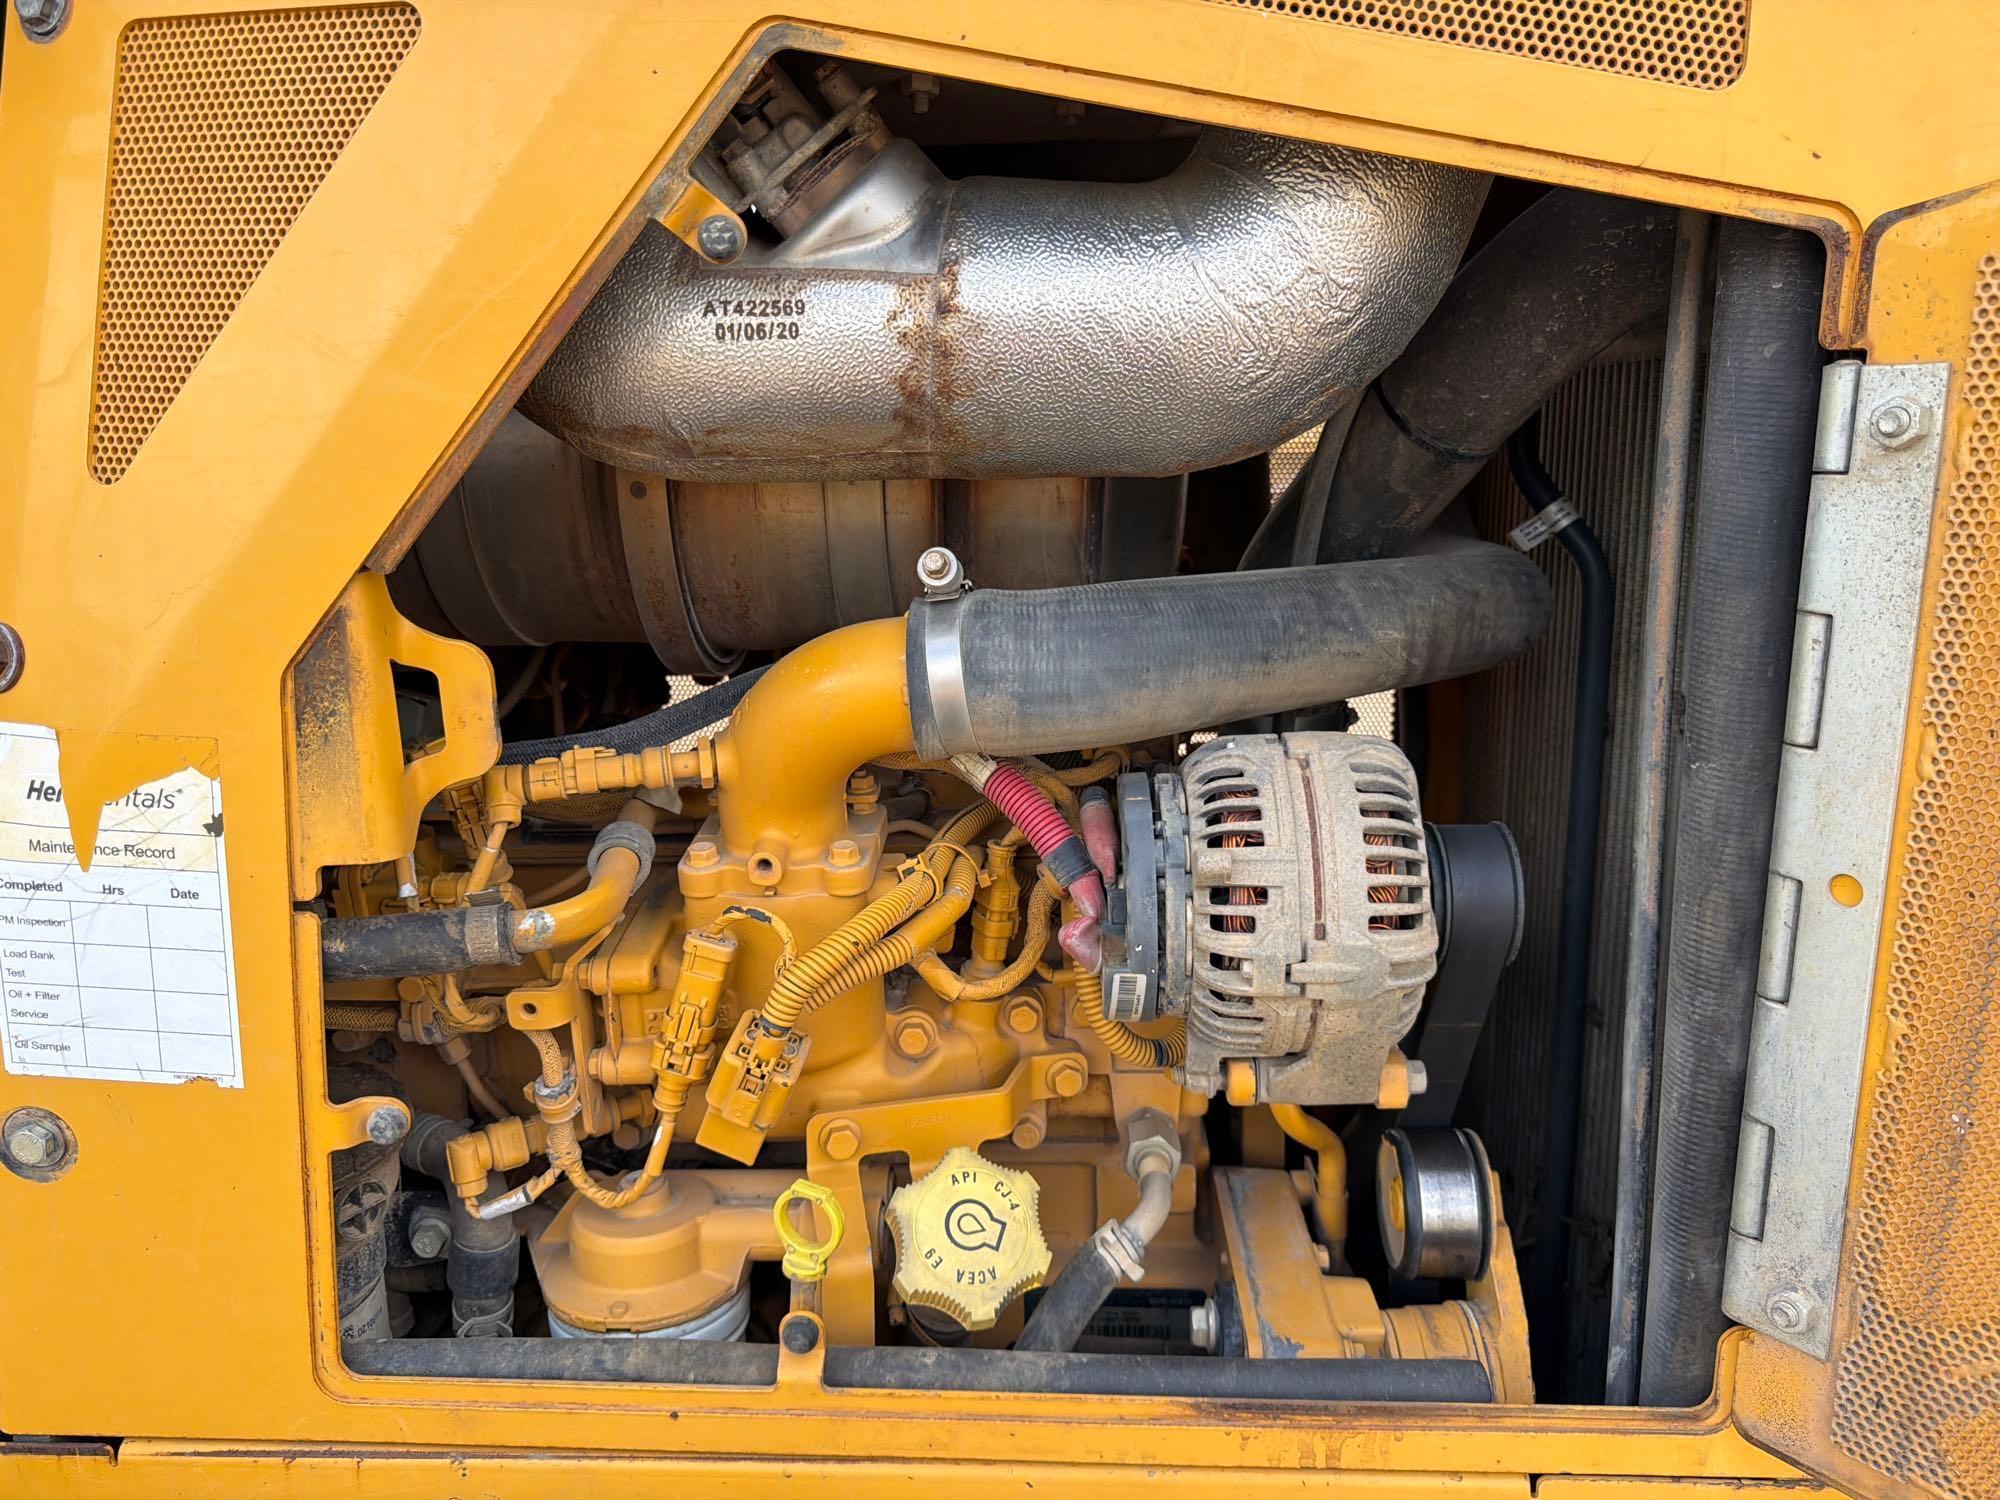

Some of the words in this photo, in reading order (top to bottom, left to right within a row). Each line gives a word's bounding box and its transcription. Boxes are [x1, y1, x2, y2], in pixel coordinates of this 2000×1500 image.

[702, 299, 806, 317] AT422569
[715, 321, 800, 341] 01/06/20
[26, 779, 62, 803] Her
[28, 838, 120, 857] Maintence
[123, 844, 176, 860] Record
[102, 884, 125, 896] Hrs
[170, 888, 200, 900] Date
[16, 916, 66, 928] Inspection
[3, 950, 28, 960] Load
[30, 951, 55, 960] Bank
[6, 968, 26, 978] Test
[8, 989, 24, 999] Oil
[35, 991, 60, 1001] Filter
[10, 1008, 49, 1019] Service
[15, 1040, 29, 1049] Oil
[31, 1041, 71, 1052] Sample
[950, 1171, 977, 1186] API
[993, 1180, 1021, 1211] CJ-4
[924, 1247, 944, 1270] E9
[956, 1265, 998, 1286] ACEA
